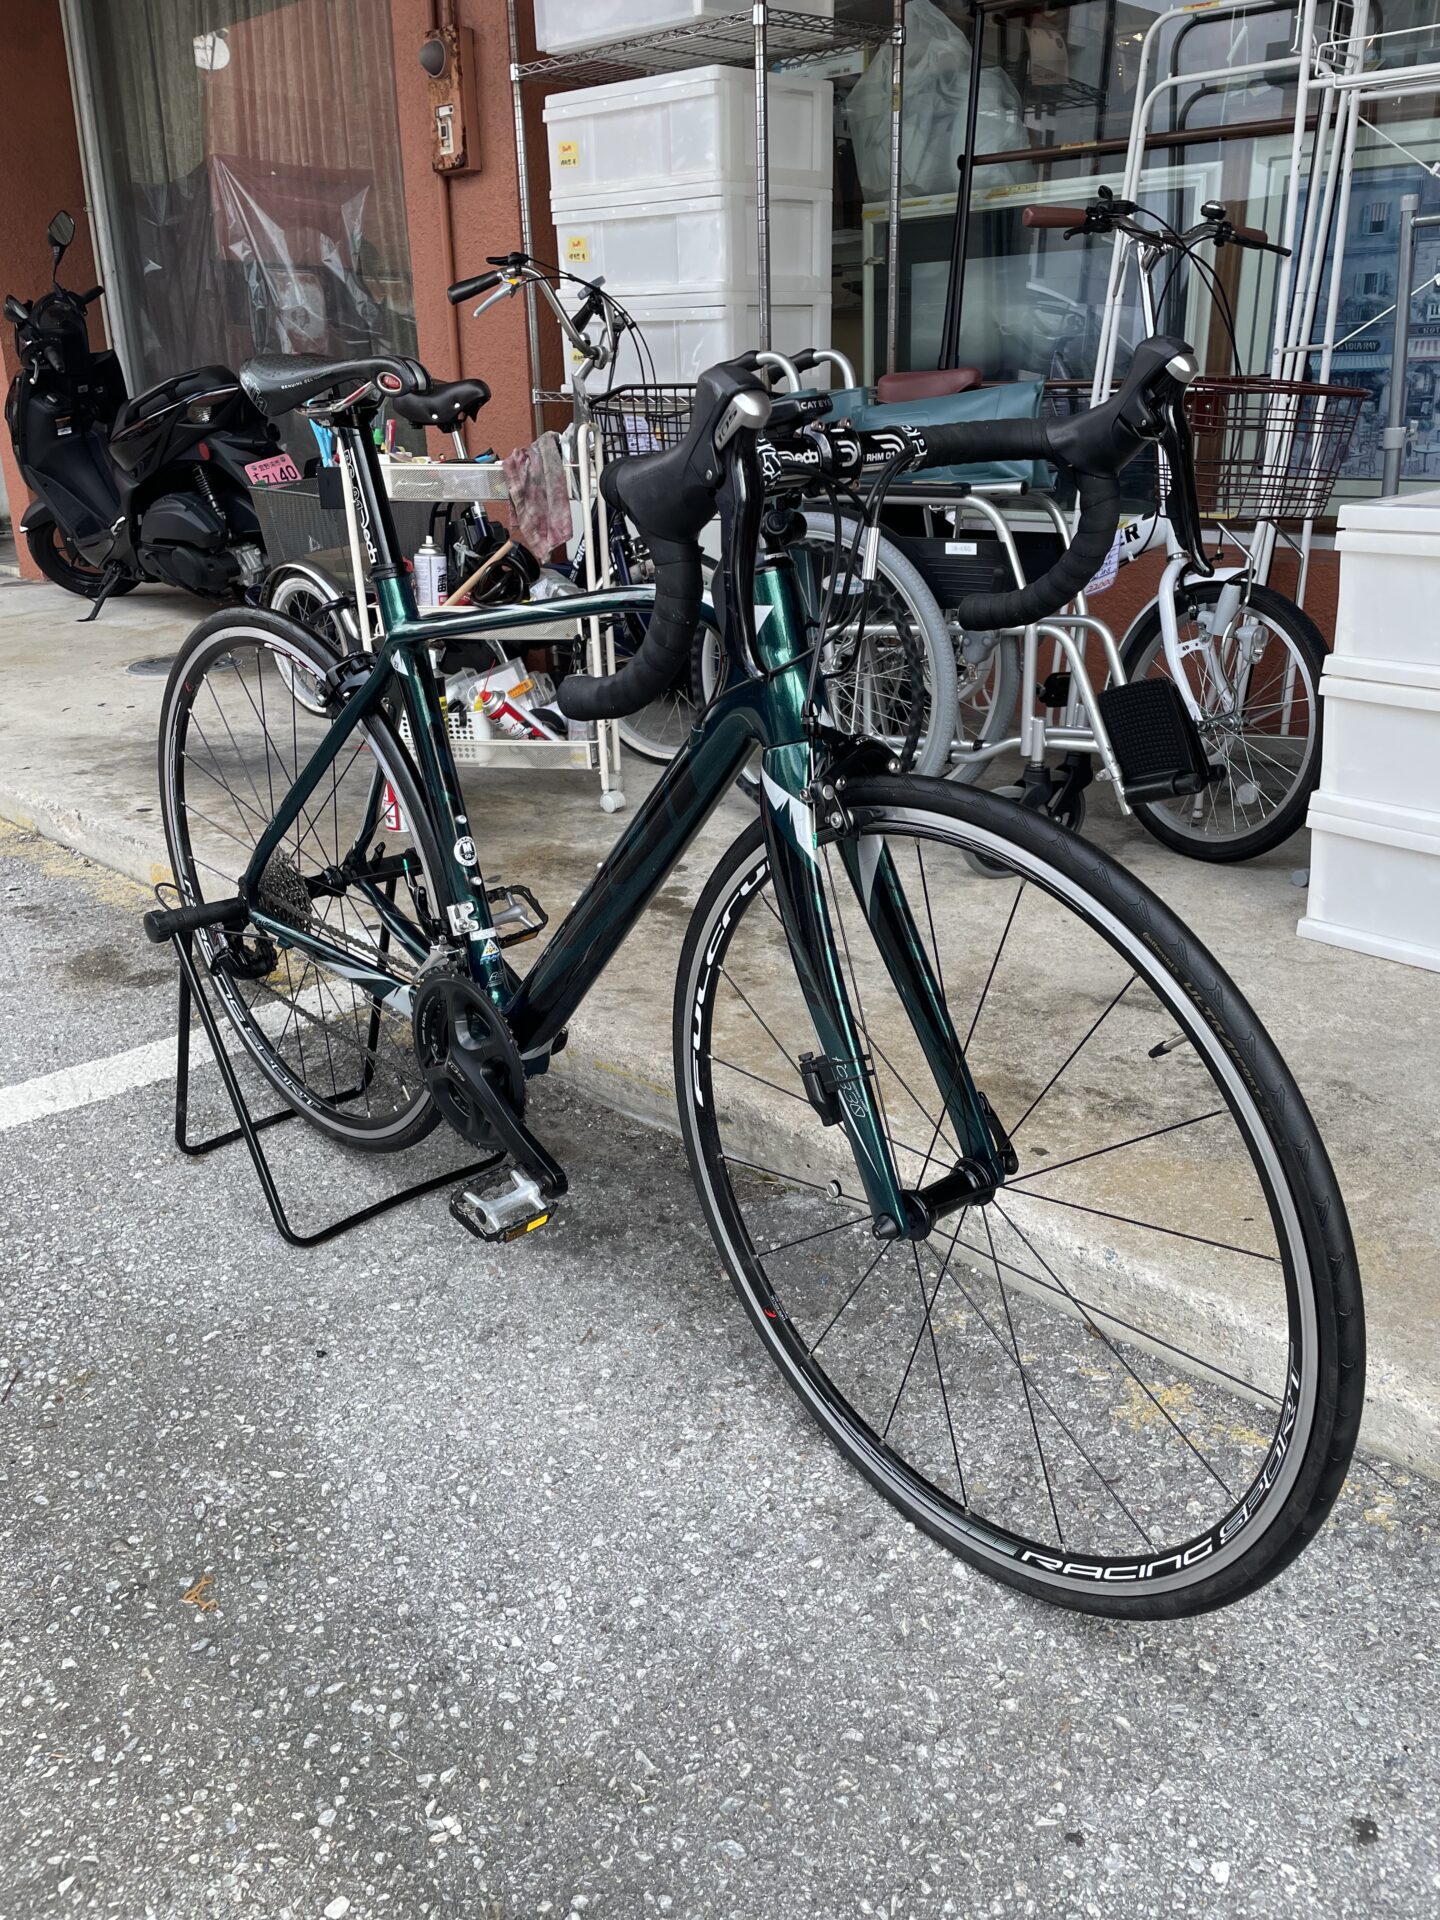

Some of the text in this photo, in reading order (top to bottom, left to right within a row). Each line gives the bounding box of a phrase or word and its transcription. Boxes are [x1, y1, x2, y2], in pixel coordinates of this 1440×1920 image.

[716, 408, 738, 444] 105
[866, 452, 884, 462] RHM
[461, 841, 473, 854] M
[693, 861, 772, 1107] FULCRU
[1021, 1537, 1212, 1580] RACING
